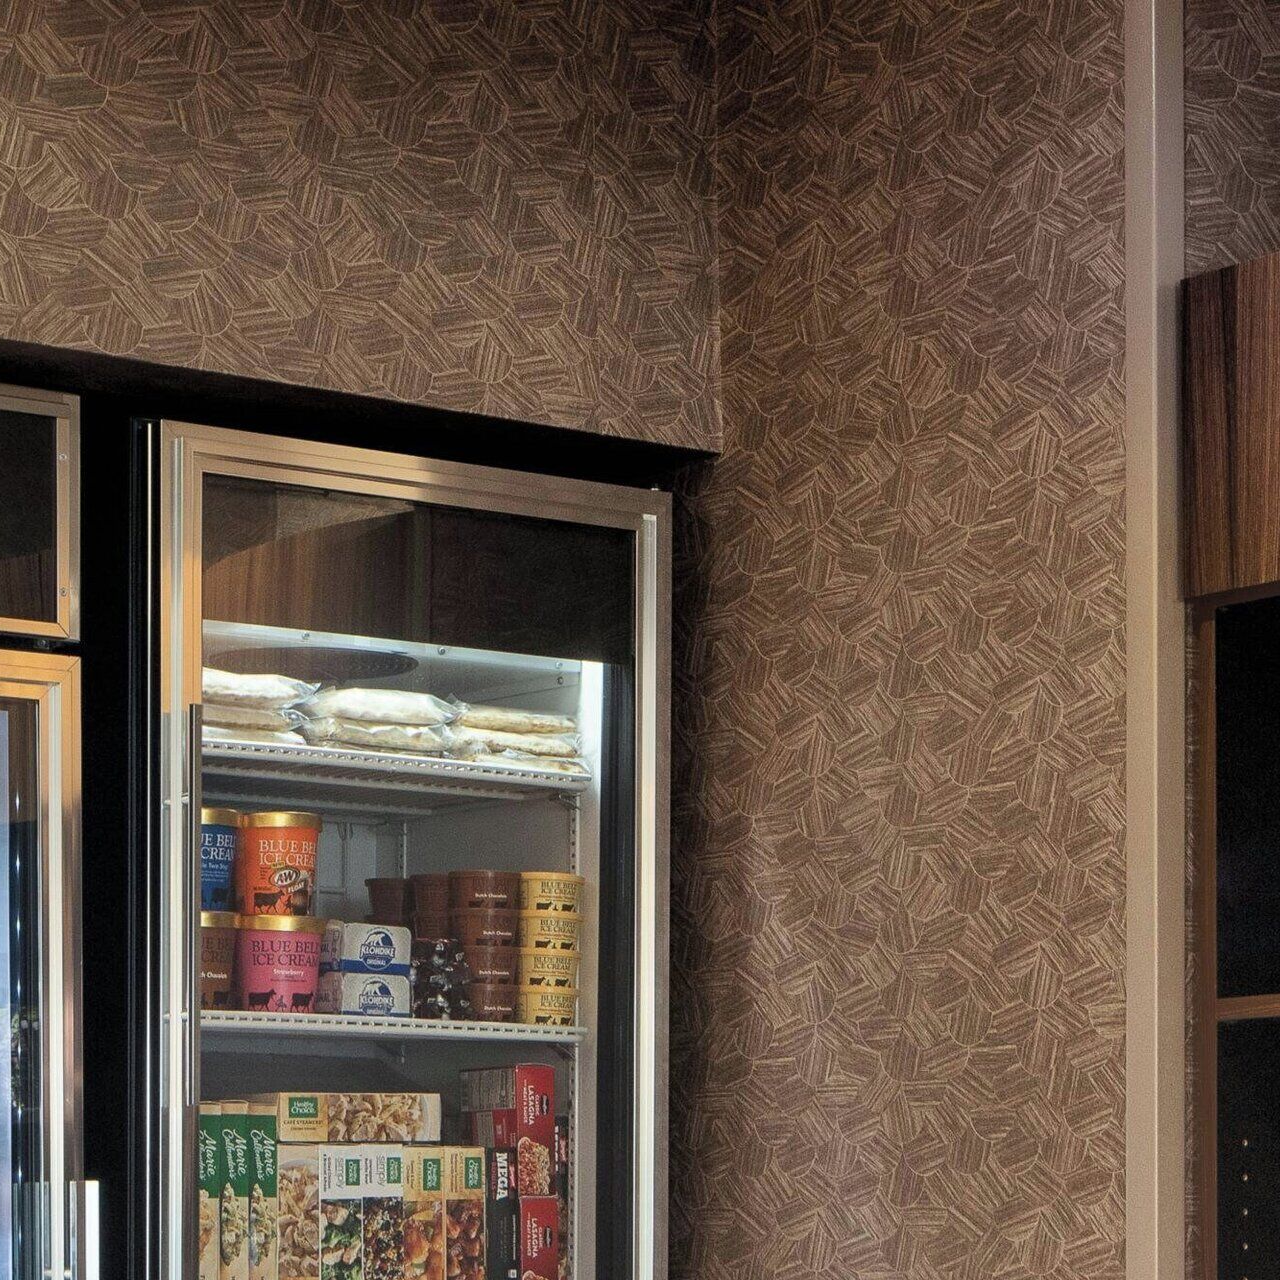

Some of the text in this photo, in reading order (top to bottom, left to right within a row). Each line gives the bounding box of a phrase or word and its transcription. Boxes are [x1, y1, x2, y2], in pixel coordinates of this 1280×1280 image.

[259, 840, 297, 852] BLUE
[259, 853, 284, 866] ICE
[285, 853, 315, 867] CREA
[252, 940, 292, 953] BLUE
[359, 943, 396, 958] KLONDIKE
[252, 953, 277, 966] ICE
[359, 993, 395, 1008] KLONDIKE
[291, 1105, 316, 1114] Choice
[527, 1085, 535, 1126] LASAGNA
[204, 1129, 217, 1177] Marie
[232, 1129, 248, 1177] Marie
[261, 1129, 275, 1177] Marie
[496, 1152, 508, 1200] MEGA
[531, 1218, 539, 1258] LASAGNA
